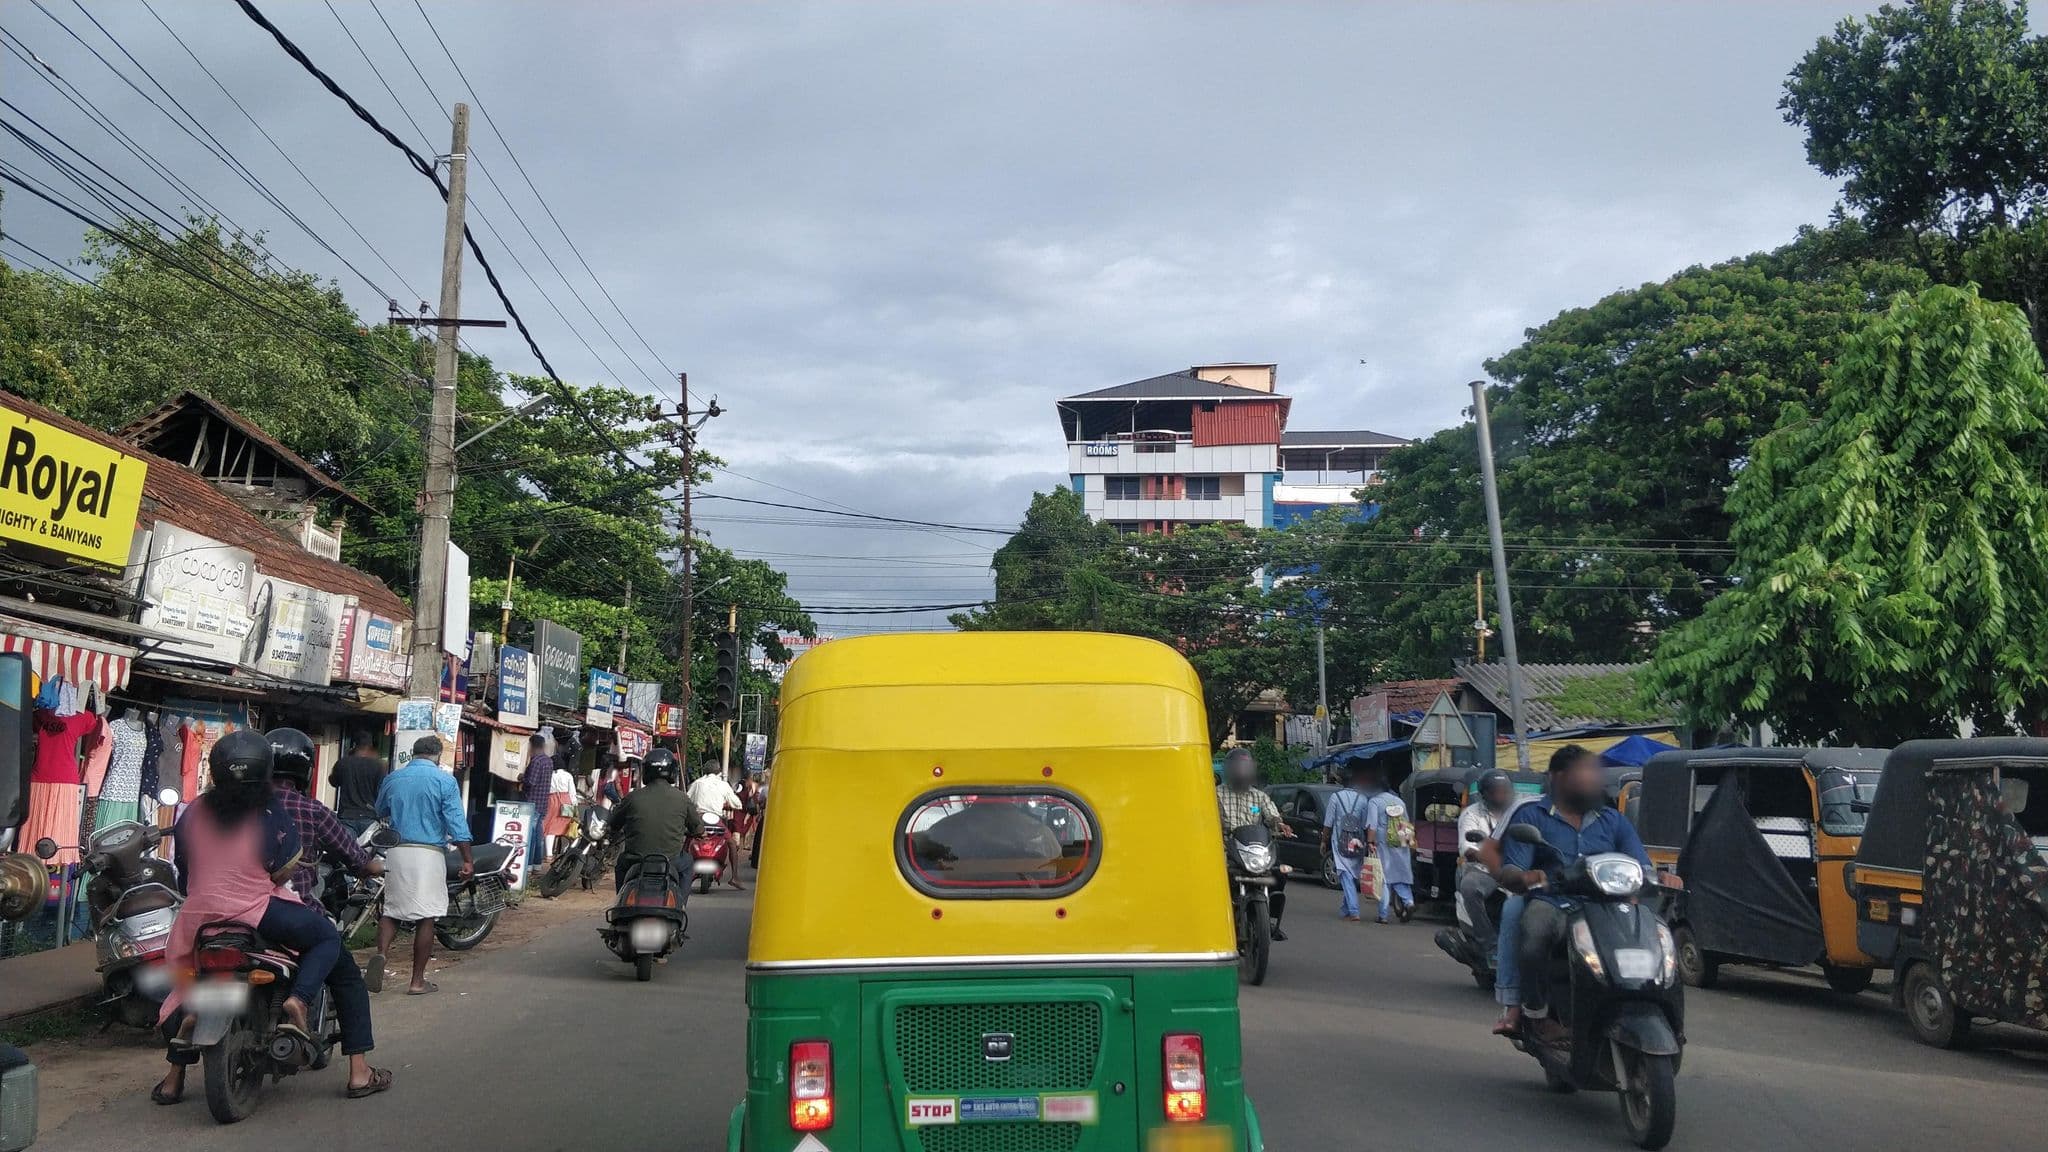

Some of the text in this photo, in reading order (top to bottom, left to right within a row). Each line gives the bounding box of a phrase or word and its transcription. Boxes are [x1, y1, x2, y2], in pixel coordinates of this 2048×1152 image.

[1087, 446, 1118, 456] ROOMS
[0, 426, 117, 521] Royal
[0, 508, 103, 549] IGHTY & BANIYANS
[912, 1105, 953, 1117] STOP
